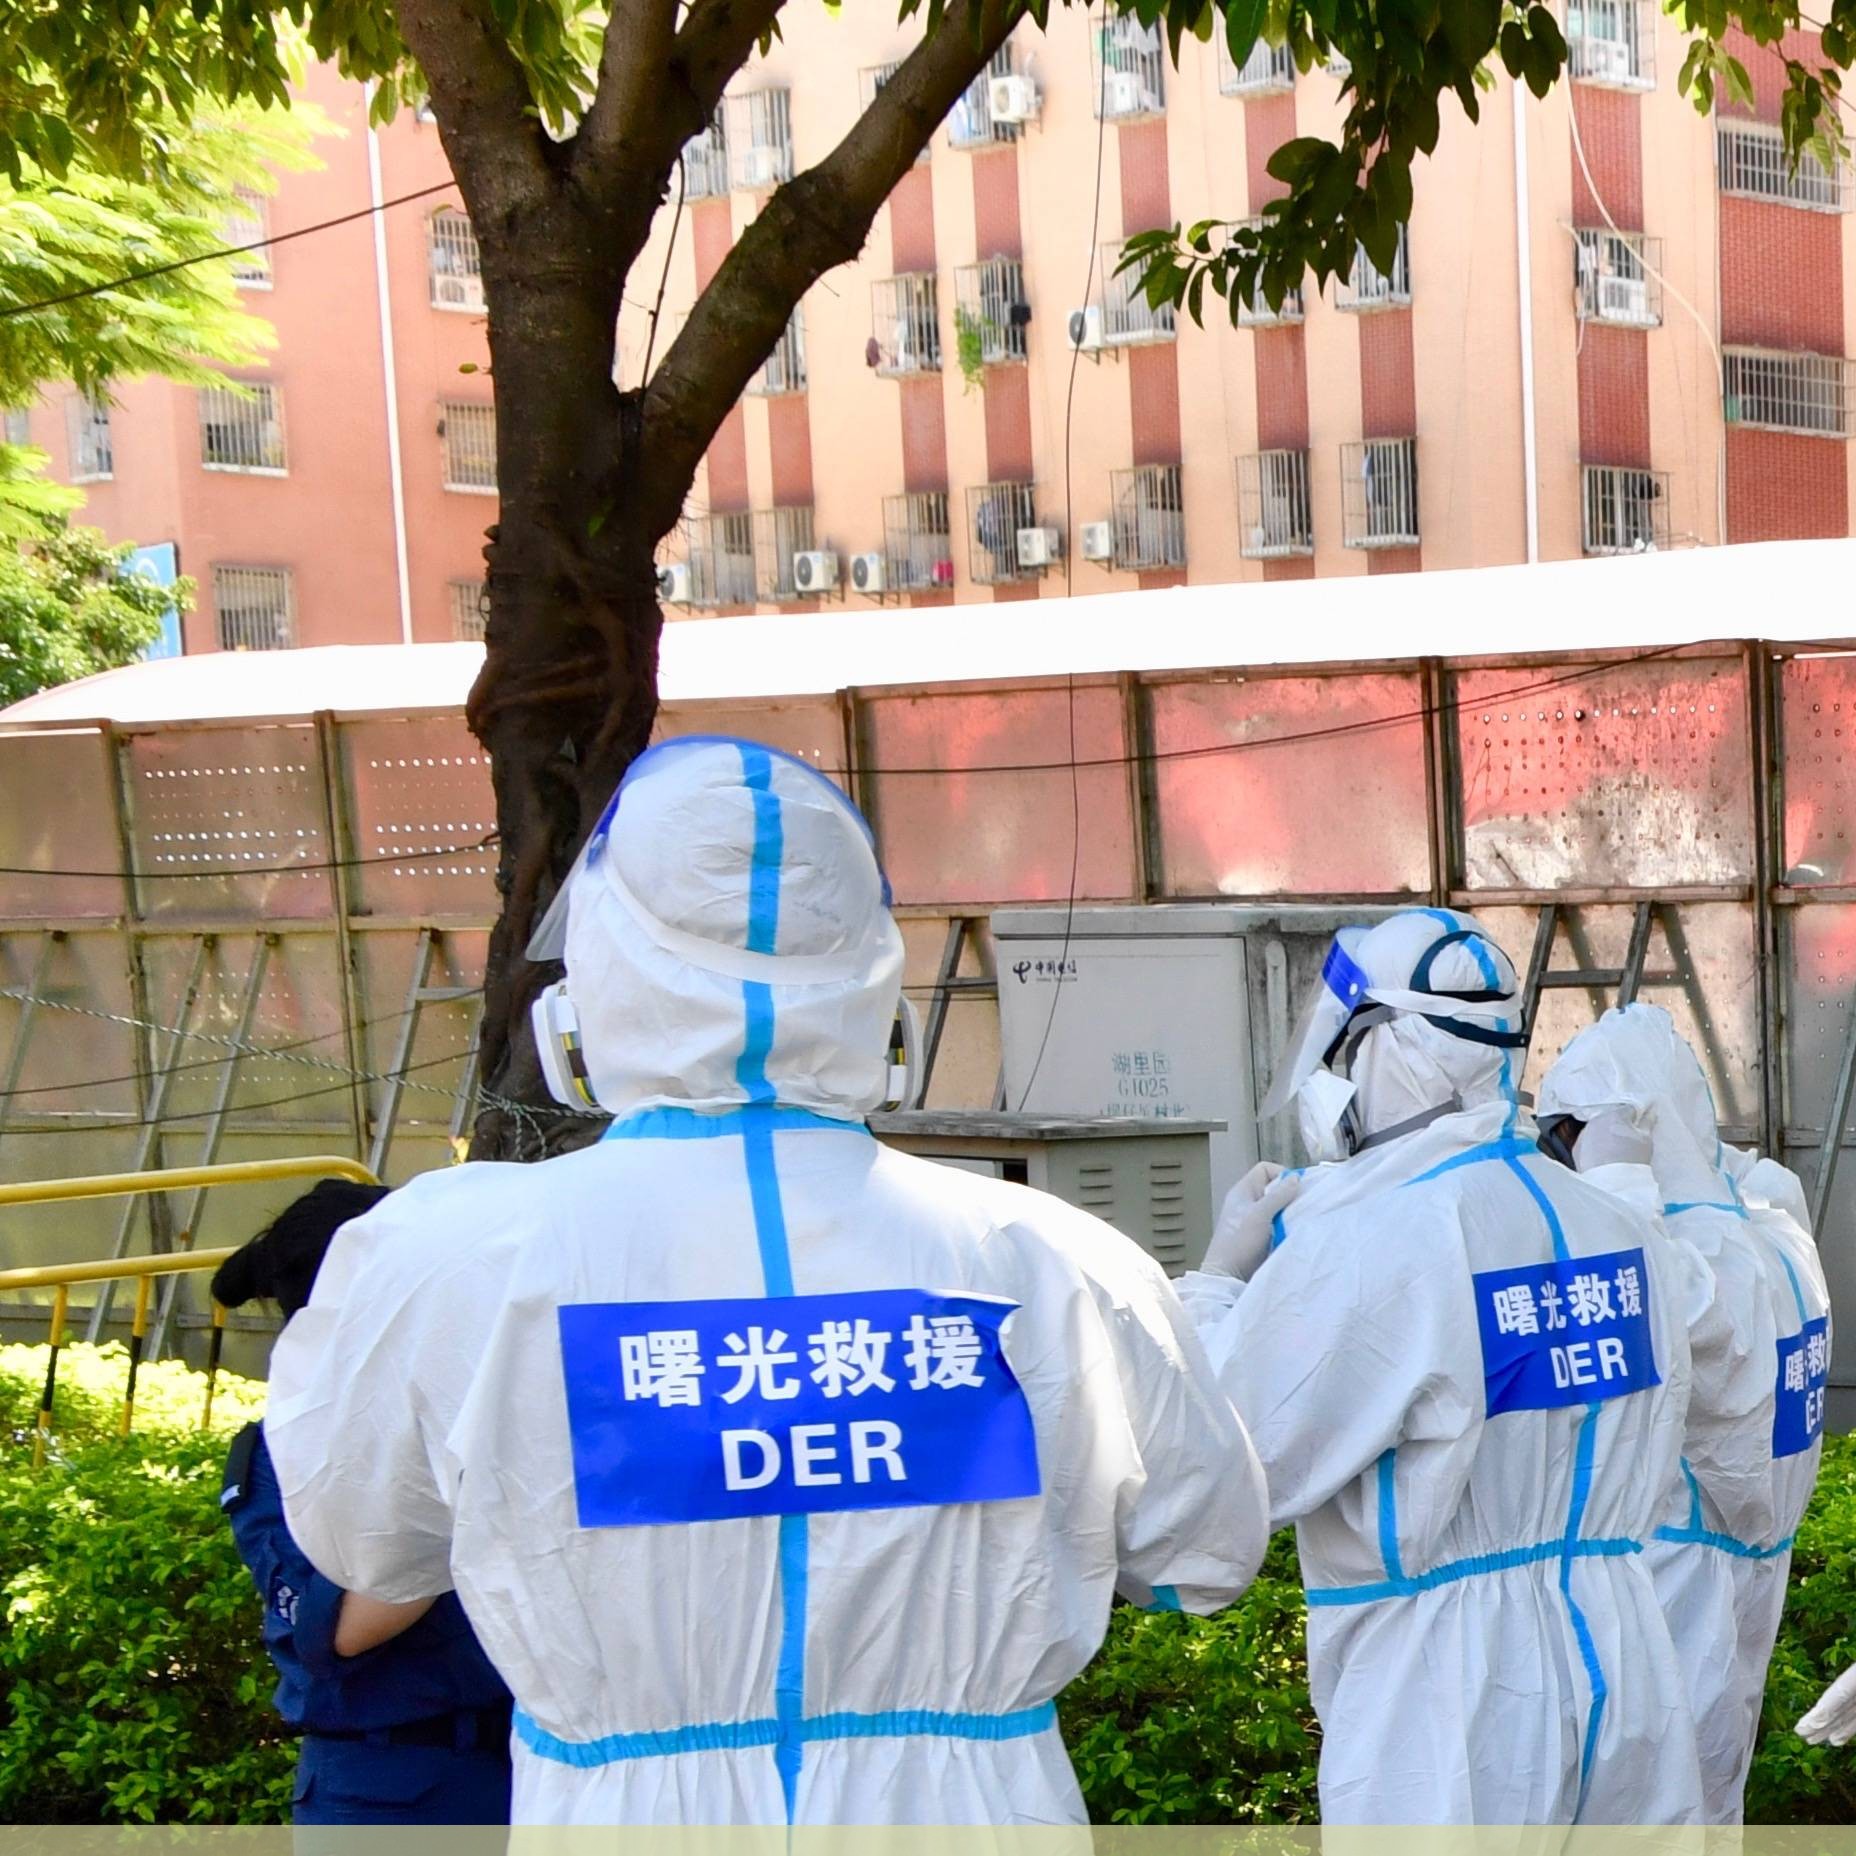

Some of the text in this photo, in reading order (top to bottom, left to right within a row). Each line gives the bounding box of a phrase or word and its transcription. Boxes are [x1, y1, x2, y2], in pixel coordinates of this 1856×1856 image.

[1493, 1266, 1642, 1336] 曙光救援
[619, 1314, 986, 1408] 曙光救援
[1551, 1337, 1628, 1389] DER
[721, 1420, 906, 1491] DER
